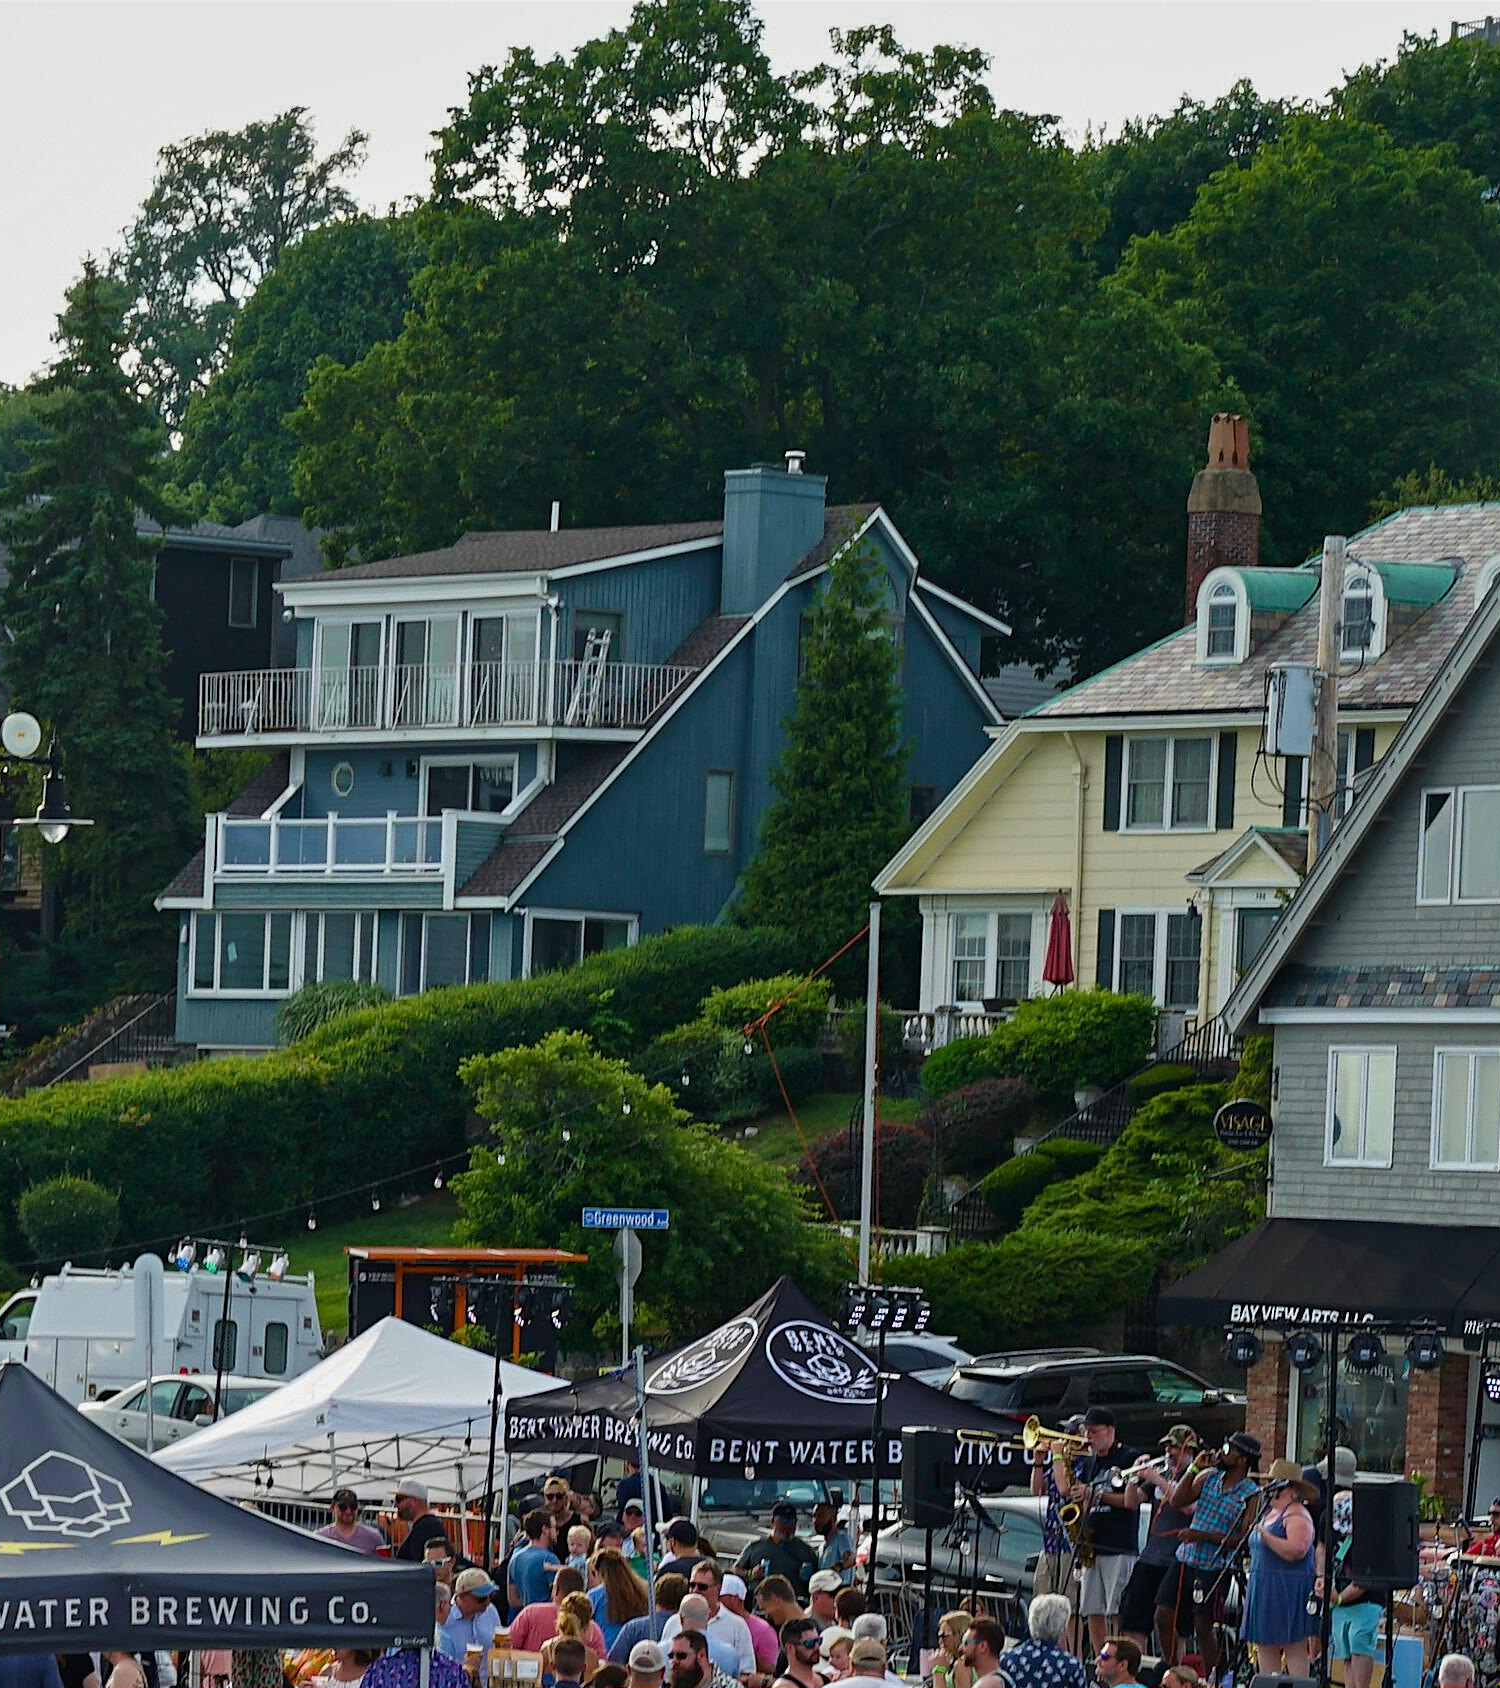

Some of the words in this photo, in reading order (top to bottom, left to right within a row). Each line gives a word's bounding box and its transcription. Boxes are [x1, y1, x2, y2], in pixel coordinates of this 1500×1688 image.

[594, 1210, 655, 1227] Greenwood
[1230, 1304, 1259, 1322] BAY
[1261, 1305, 1299, 1323] VIEW
[508, 1415, 545, 1440] BENT
[710, 1438, 779, 1464] BENT
[788, 1440, 876, 1464] WATER
[130, 1596, 310, 1628] BREWING
